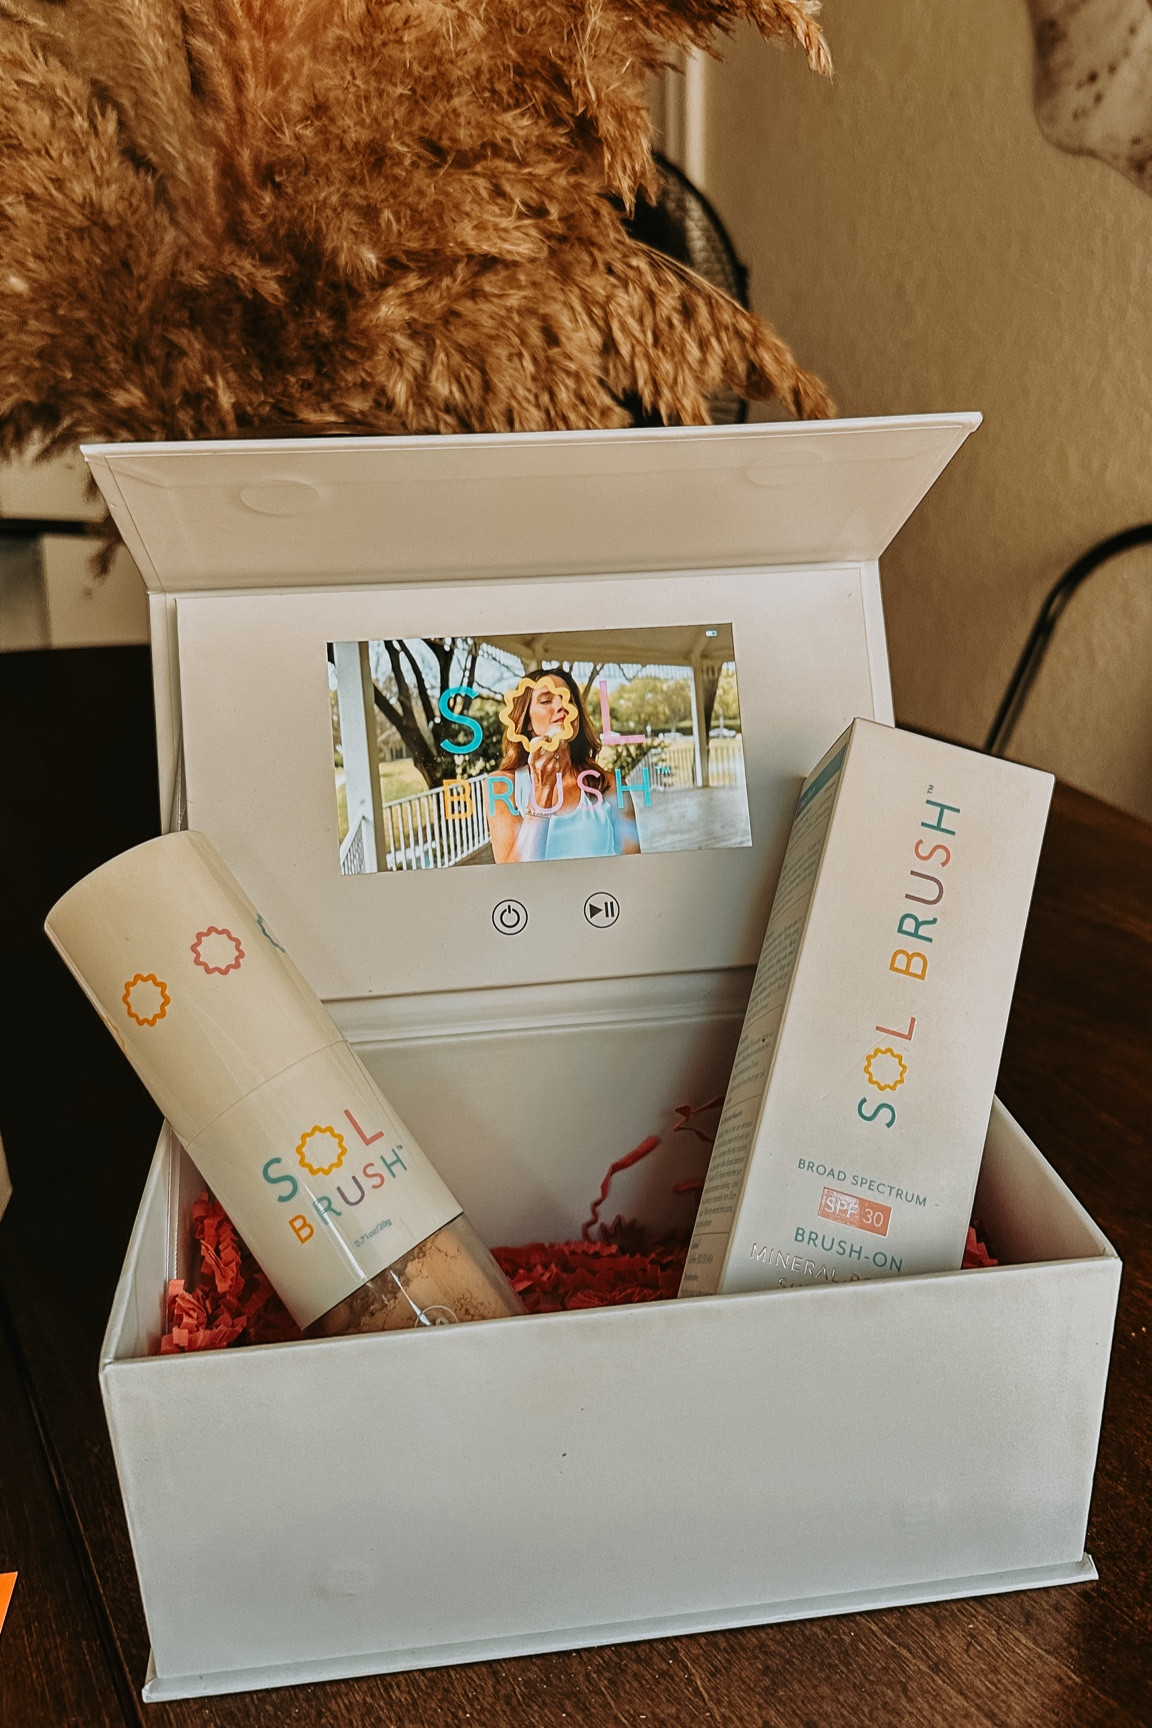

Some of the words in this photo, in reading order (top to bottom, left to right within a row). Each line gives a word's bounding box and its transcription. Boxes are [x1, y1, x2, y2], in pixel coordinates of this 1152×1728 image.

[438, 677, 646, 754] SOL
[857, 1016, 917, 1130] SOL
[263, 1109, 384, 1202] SOL
[798, 1158, 847, 1182] BROAD
[851, 1175, 927, 1207] SPECTRUM
[824, 1195, 859, 1217] SPF
[862, 1208, 885, 1228] 30
[750, 1242, 839, 1282] MINERAL
[794, 1226, 903, 1273] BRUSH-ON
